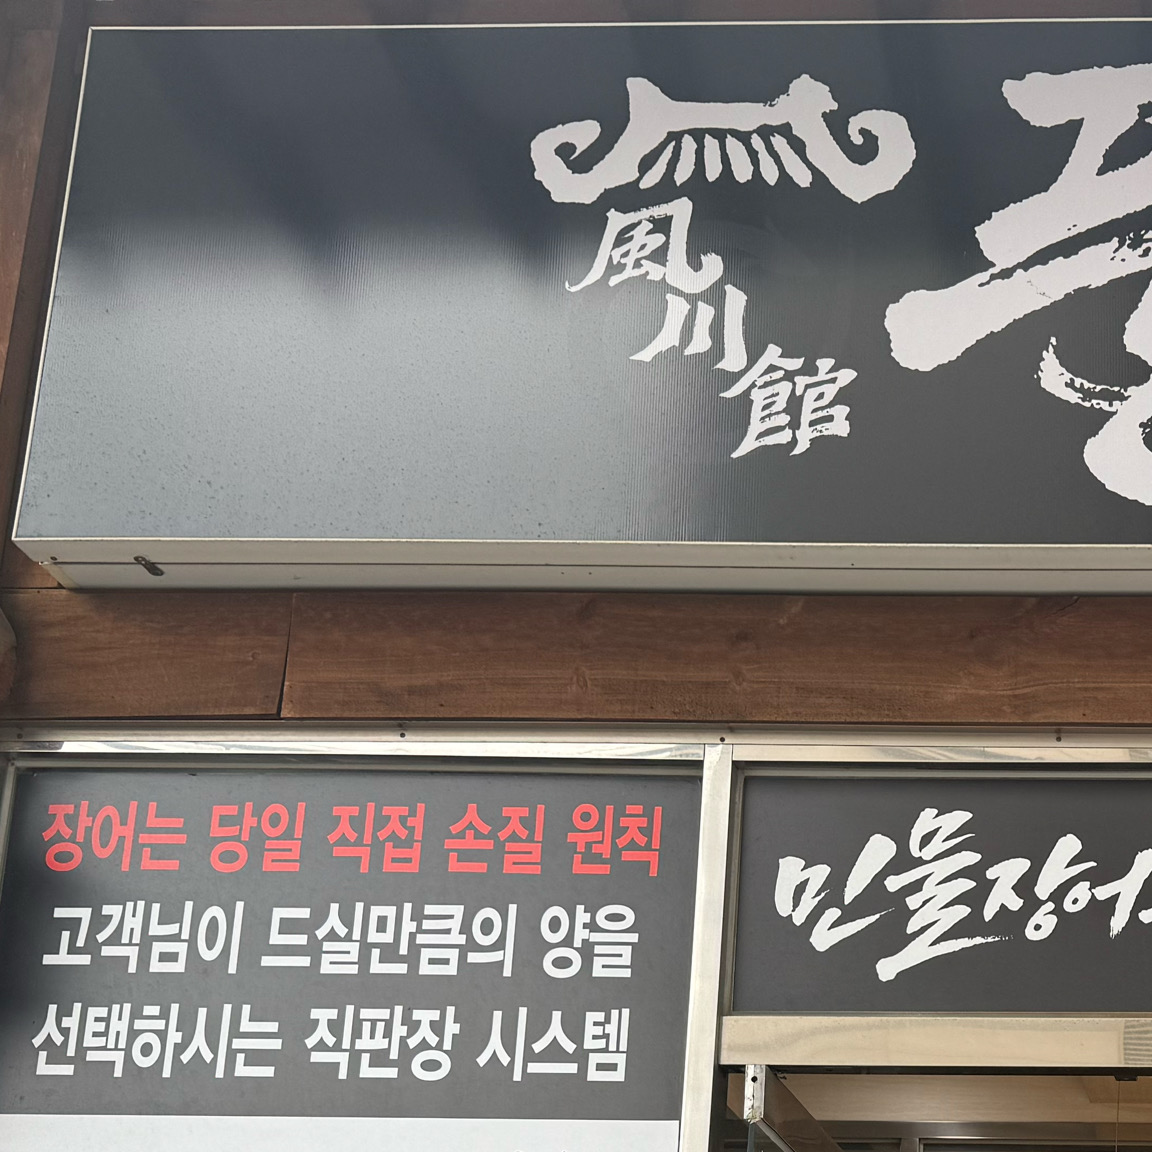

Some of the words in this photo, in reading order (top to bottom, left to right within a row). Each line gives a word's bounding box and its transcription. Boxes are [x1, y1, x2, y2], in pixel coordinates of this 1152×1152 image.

[566, 198, 857, 458] 風川館
[43, 802, 186, 871] 장어는
[211, 803, 305, 872] 당일
[328, 803, 425, 873] 직접
[445, 804, 544, 874] 손질
[568, 804, 662, 876] 원칙
[43, 900, 244, 974] 고객님이
[261, 902, 517, 977] 드실만큼의
[540, 905, 639, 978] 양을
[32, 1003, 282, 1078] 선택하시는
[304, 1005, 460, 1081] 직판장
[476, 1007, 629, 1081] 시스템
